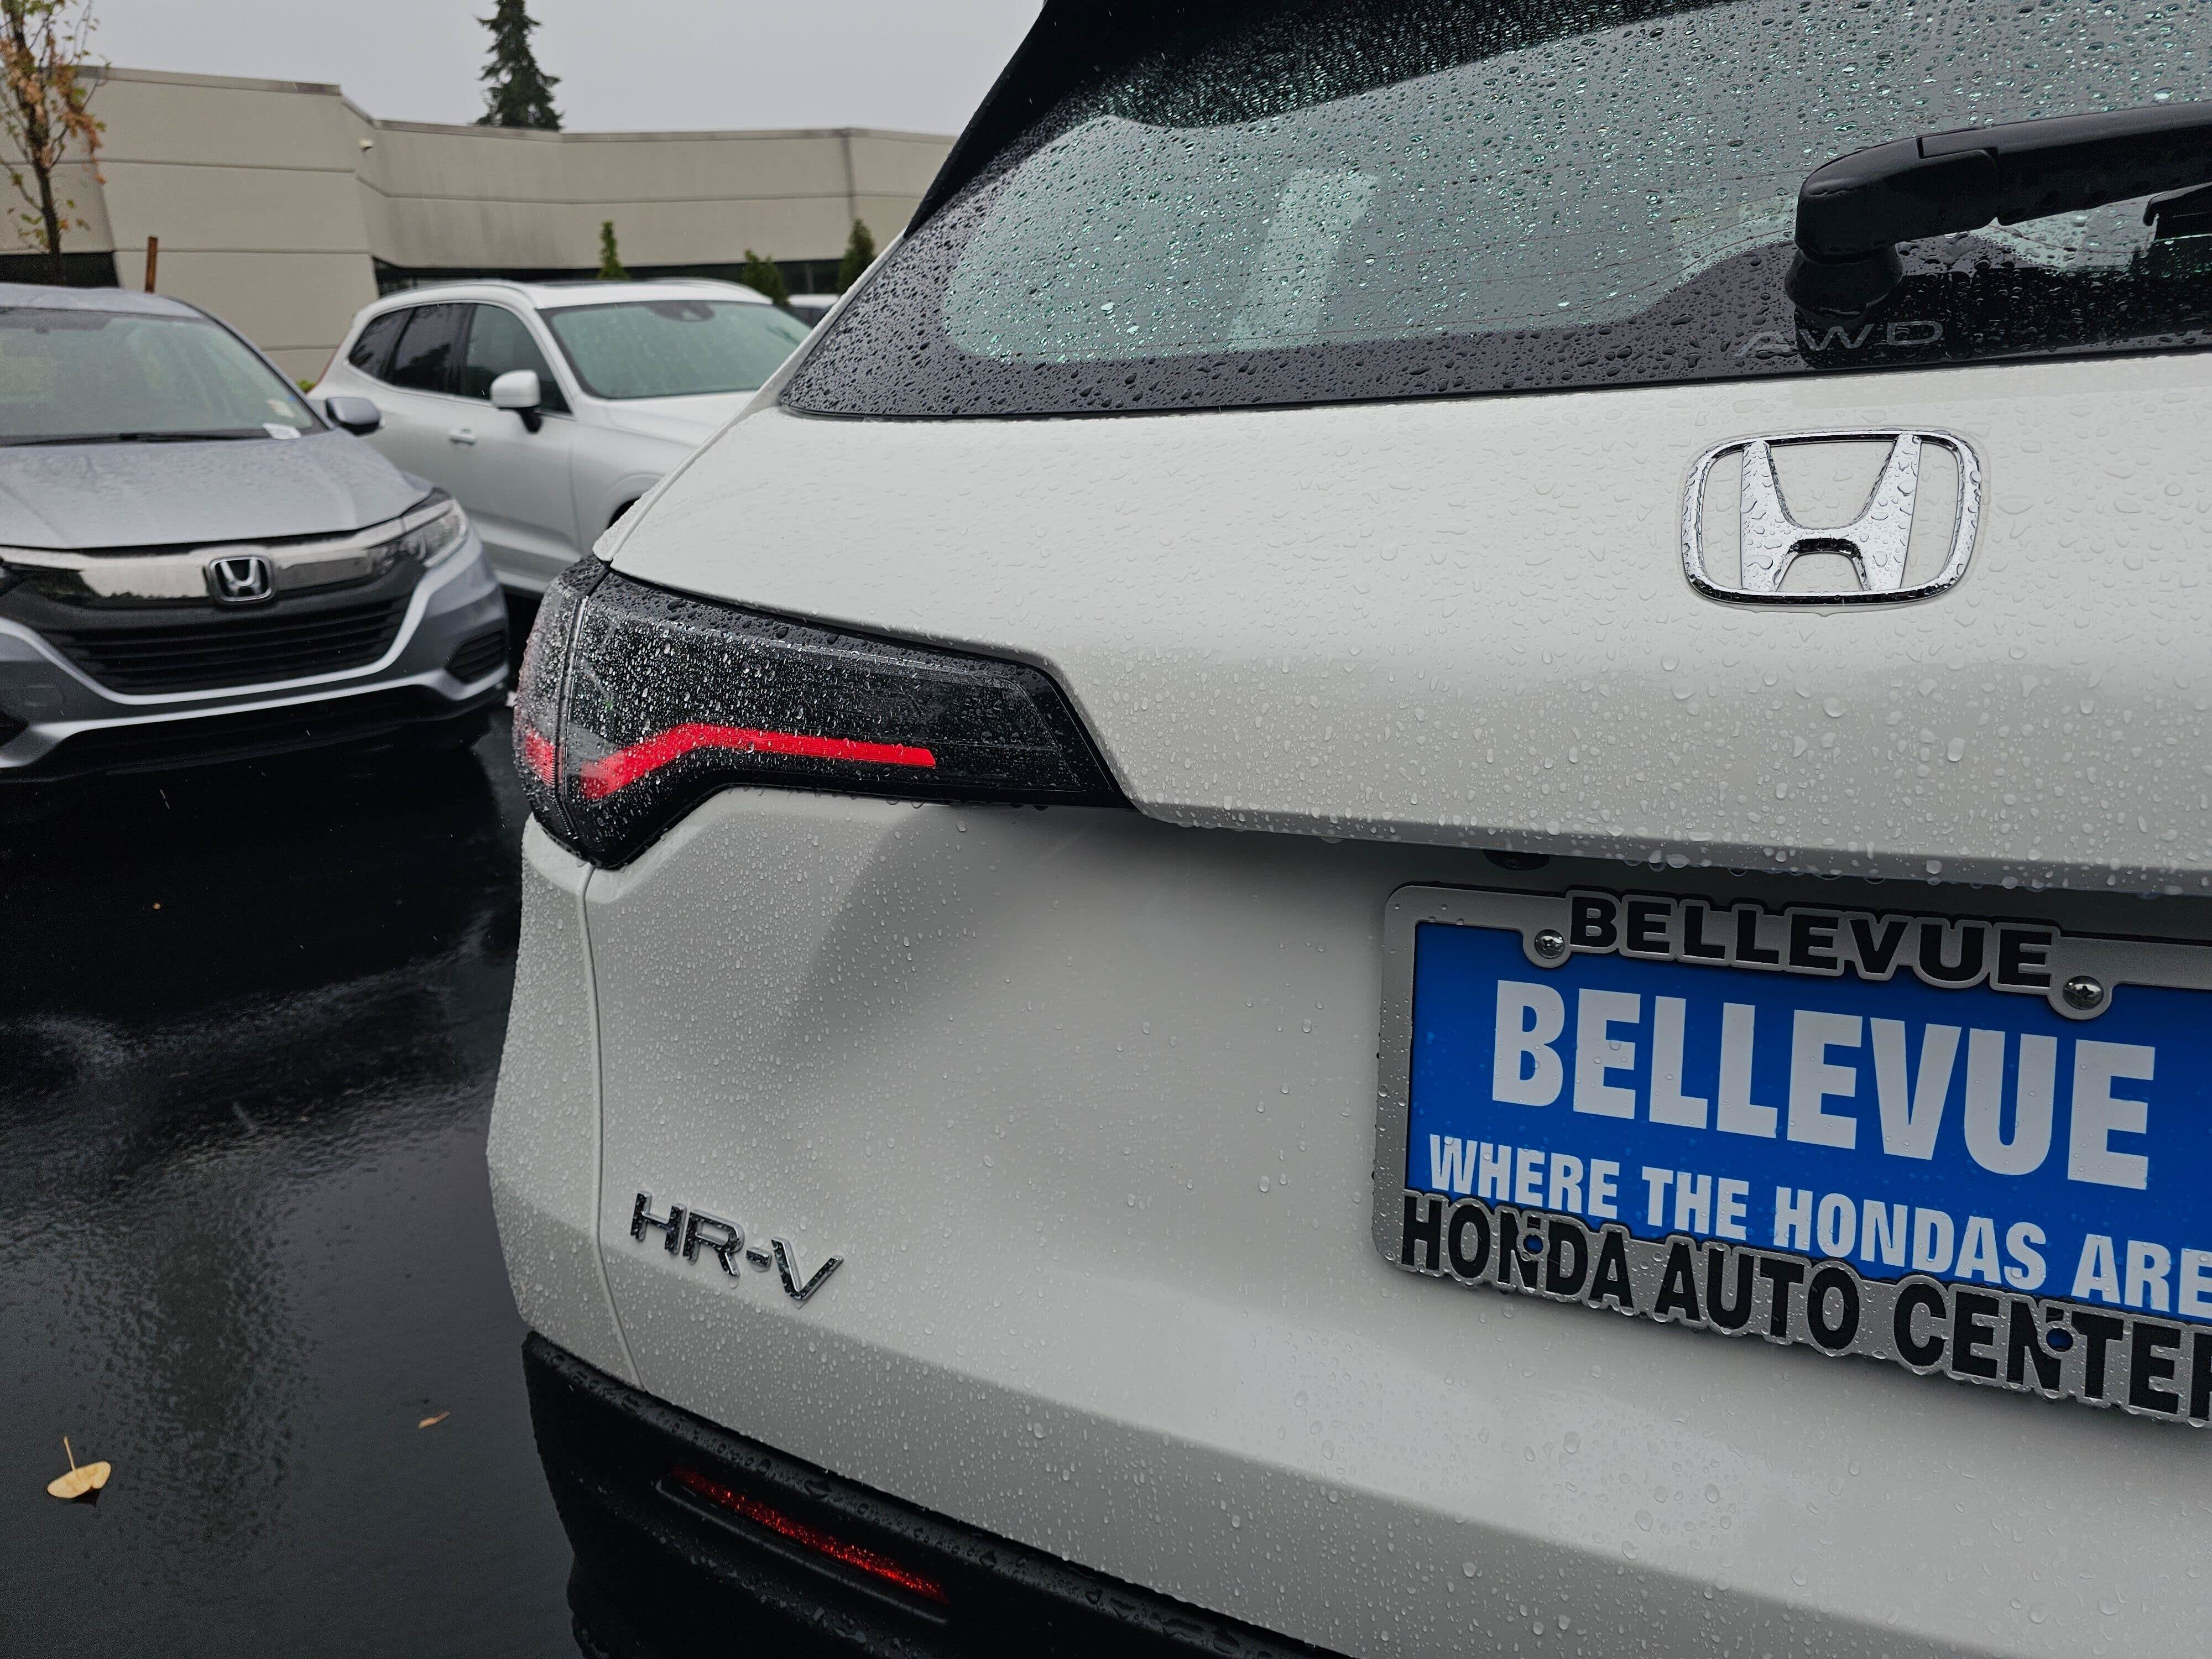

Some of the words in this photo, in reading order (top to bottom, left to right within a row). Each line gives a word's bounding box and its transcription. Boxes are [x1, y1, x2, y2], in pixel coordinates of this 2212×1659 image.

[1730, 320, 1944, 359] AWD
[1569, 896, 2053, 988] BELLEVUE
[1492, 979, 2157, 1191] BELLEVUE
[630, 1190, 844, 1300] HR-V
[1400, 1197, 1632, 1312] HONDA
[1652, 1243, 1860, 1350] AUTO
[1429, 1134, 1620, 1219] WHERE
[1641, 1167, 1750, 1238] THE
[1773, 1188, 2047, 1291] HONDAS
[2070, 1233, 2212, 1319] ARE
